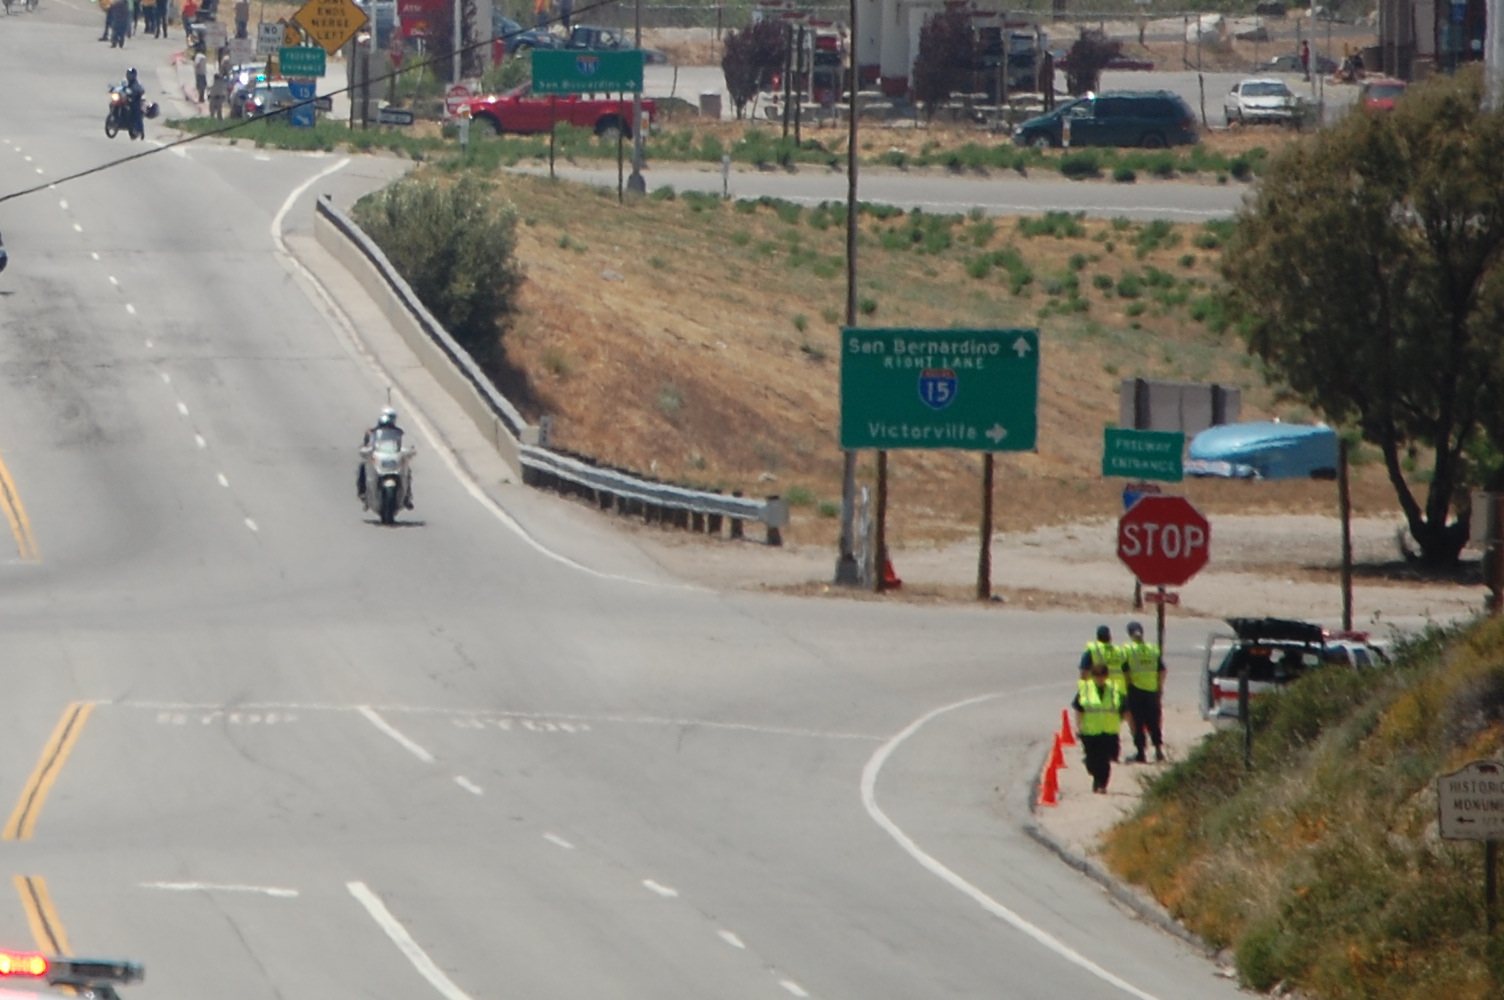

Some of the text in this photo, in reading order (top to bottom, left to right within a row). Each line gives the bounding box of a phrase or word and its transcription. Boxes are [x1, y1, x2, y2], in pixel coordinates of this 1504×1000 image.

[317, 7, 345, 17] ENDS
[264, 26, 277, 34] NO
[311, 18, 349, 28] MERGE
[317, 31, 344, 41] LEFT
[299, 87, 310, 98] 15
[849, 338, 1000, 355] San Bernardino
[884, 356, 984, 369] RIGHT LANE
[926, 381, 950, 402] 15
[868, 422, 978, 441] Victorville
[1116, 437, 1171, 453] FREEWAY
[1112, 457, 1176, 475] ENTRANCE
[1121, 522, 1205, 559] STOP
